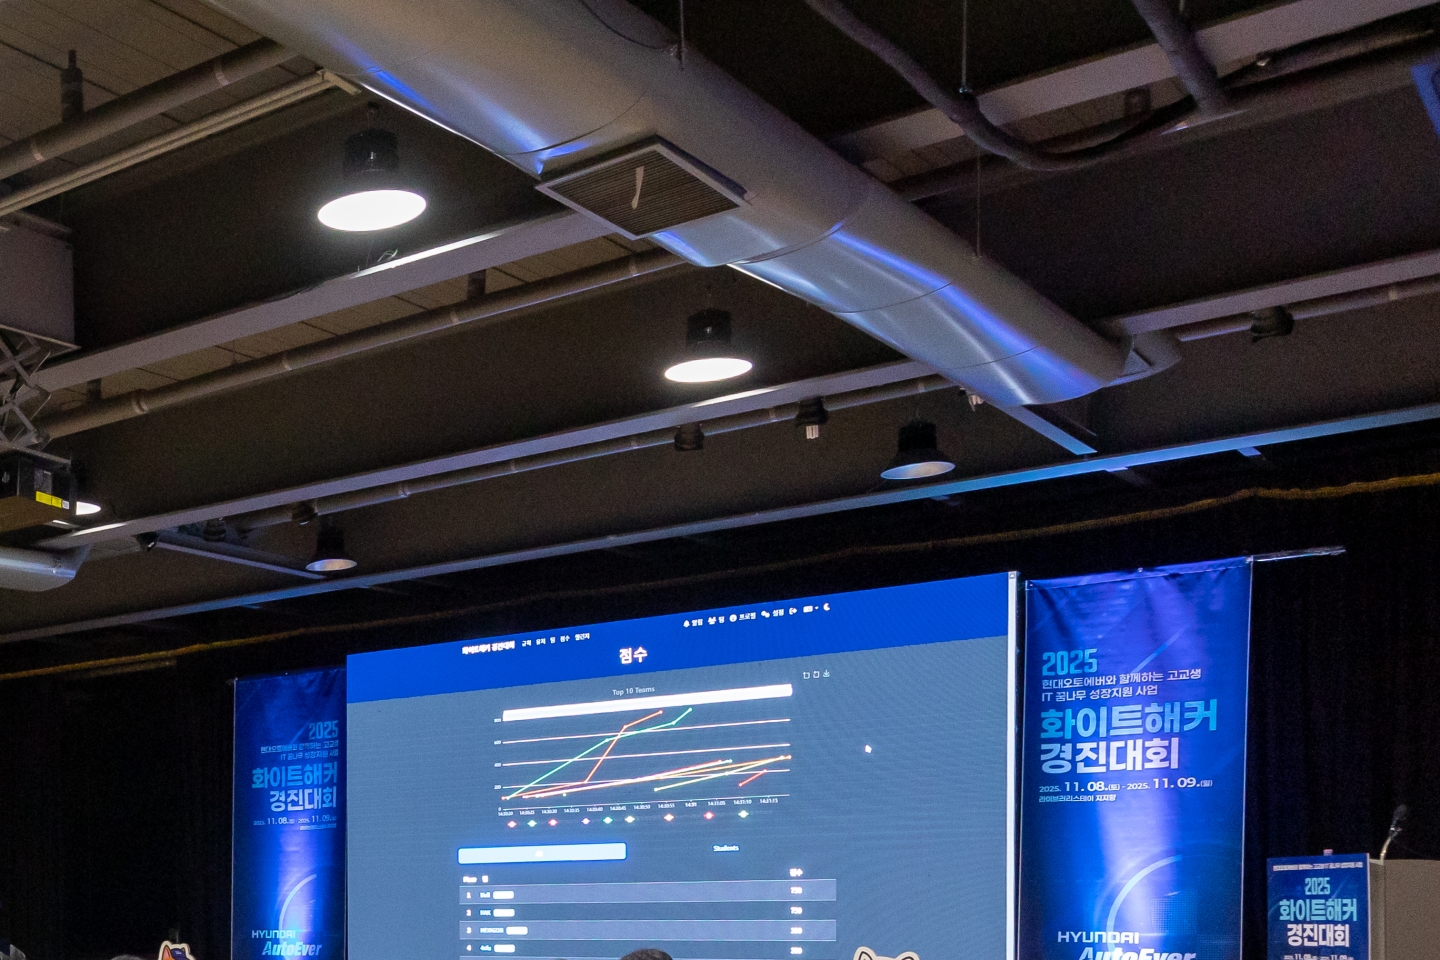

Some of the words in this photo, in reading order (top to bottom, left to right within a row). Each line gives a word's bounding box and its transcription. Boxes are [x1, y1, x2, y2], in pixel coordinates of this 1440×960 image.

[619, 646, 648, 665] 점수
[1042, 648, 1098, 676] 2025
[1042, 676, 1117, 690] 현대오토에버와
[1119, 671, 1164, 684] 함께하는
[1166, 668, 1202, 681] 고교생
[612, 689, 624, 697] Top
[635, 686, 655, 694] Teams
[1042, 692, 1053, 702] IT
[1055, 690, 1086, 702] 꿈나무
[1089, 687, 1133, 700] 성장지원
[1135, 685, 1158, 696] 사업
[1040, 699, 1218, 739] 화이트해커
[309, 720, 338, 740] 2025
[1040, 737, 1179, 774] 경진대회
[252, 761, 338, 788] 화이트해커
[1039, 785, 1062, 793] 2025.
[1127, 783, 1151, 791] 2025.
[269, 786, 337, 812] 경진대회
[1305, 877, 1331, 895] 2025
[1279, 898, 1358, 921] 화이트해커
[251, 930, 296, 938] HYUNDAI
[1057, 931, 1140, 944] HYUNDAI
[1287, 923, 1350, 947] 경진대회
[262, 941, 322, 956] AutoEver
